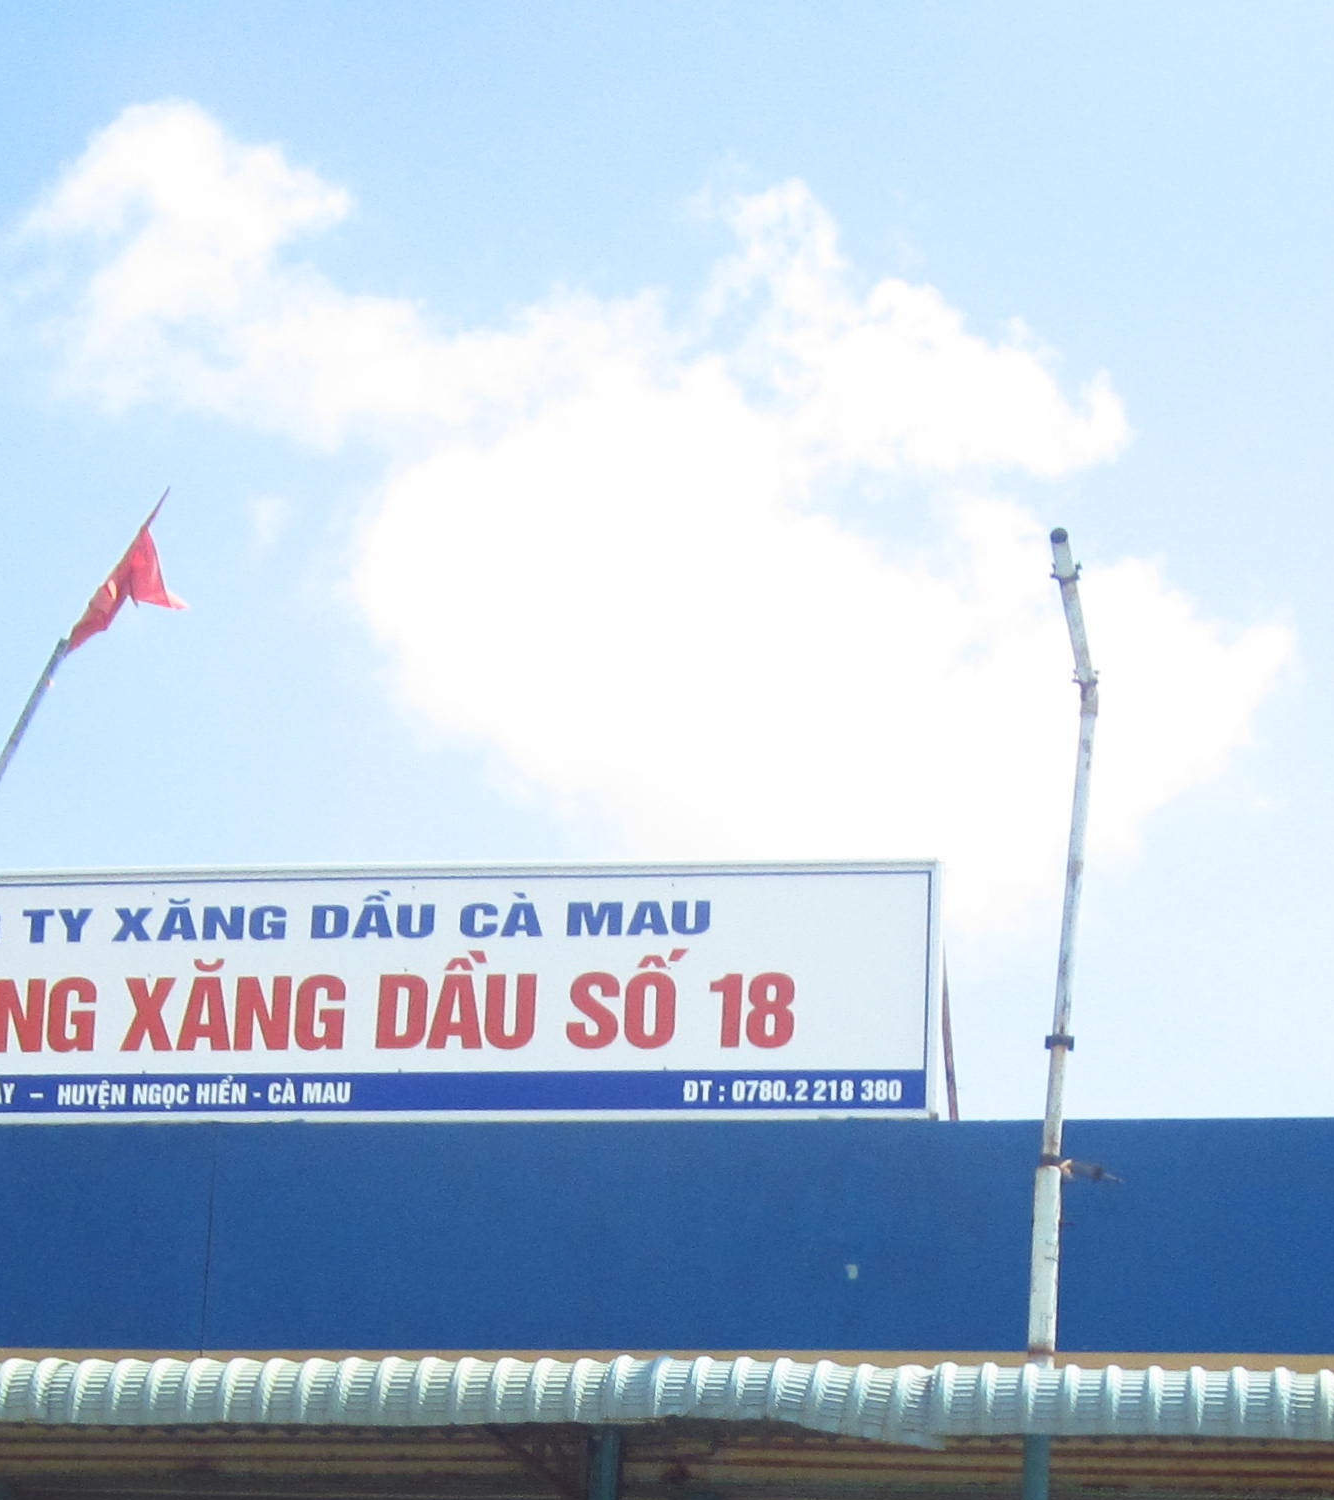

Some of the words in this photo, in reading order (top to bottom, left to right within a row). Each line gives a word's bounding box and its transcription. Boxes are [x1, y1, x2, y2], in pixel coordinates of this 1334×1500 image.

[22, 909, 92, 943] TY
[112, 898, 287, 943] XĂNG
[310, 890, 436, 938] DẦU
[459, 892, 542, 937] CÀ
[567, 900, 711, 936] MAU
[119, 957, 347, 1054] XĂNG
[375, 950, 537, 1050] DẦU
[566, 948, 689, 1049] SỐ
[709, 973, 795, 1049] 18
[58, 1080, 126, 1109] HUYỆN
[132, 1083, 190, 1109] NGỌC
[196, 1075, 247, 1105] HIỂN
[268, 1078, 296, 1104] CÀ
[302, 1082, 351, 1104] MAU
[861, 1080, 902, 1102] 380
